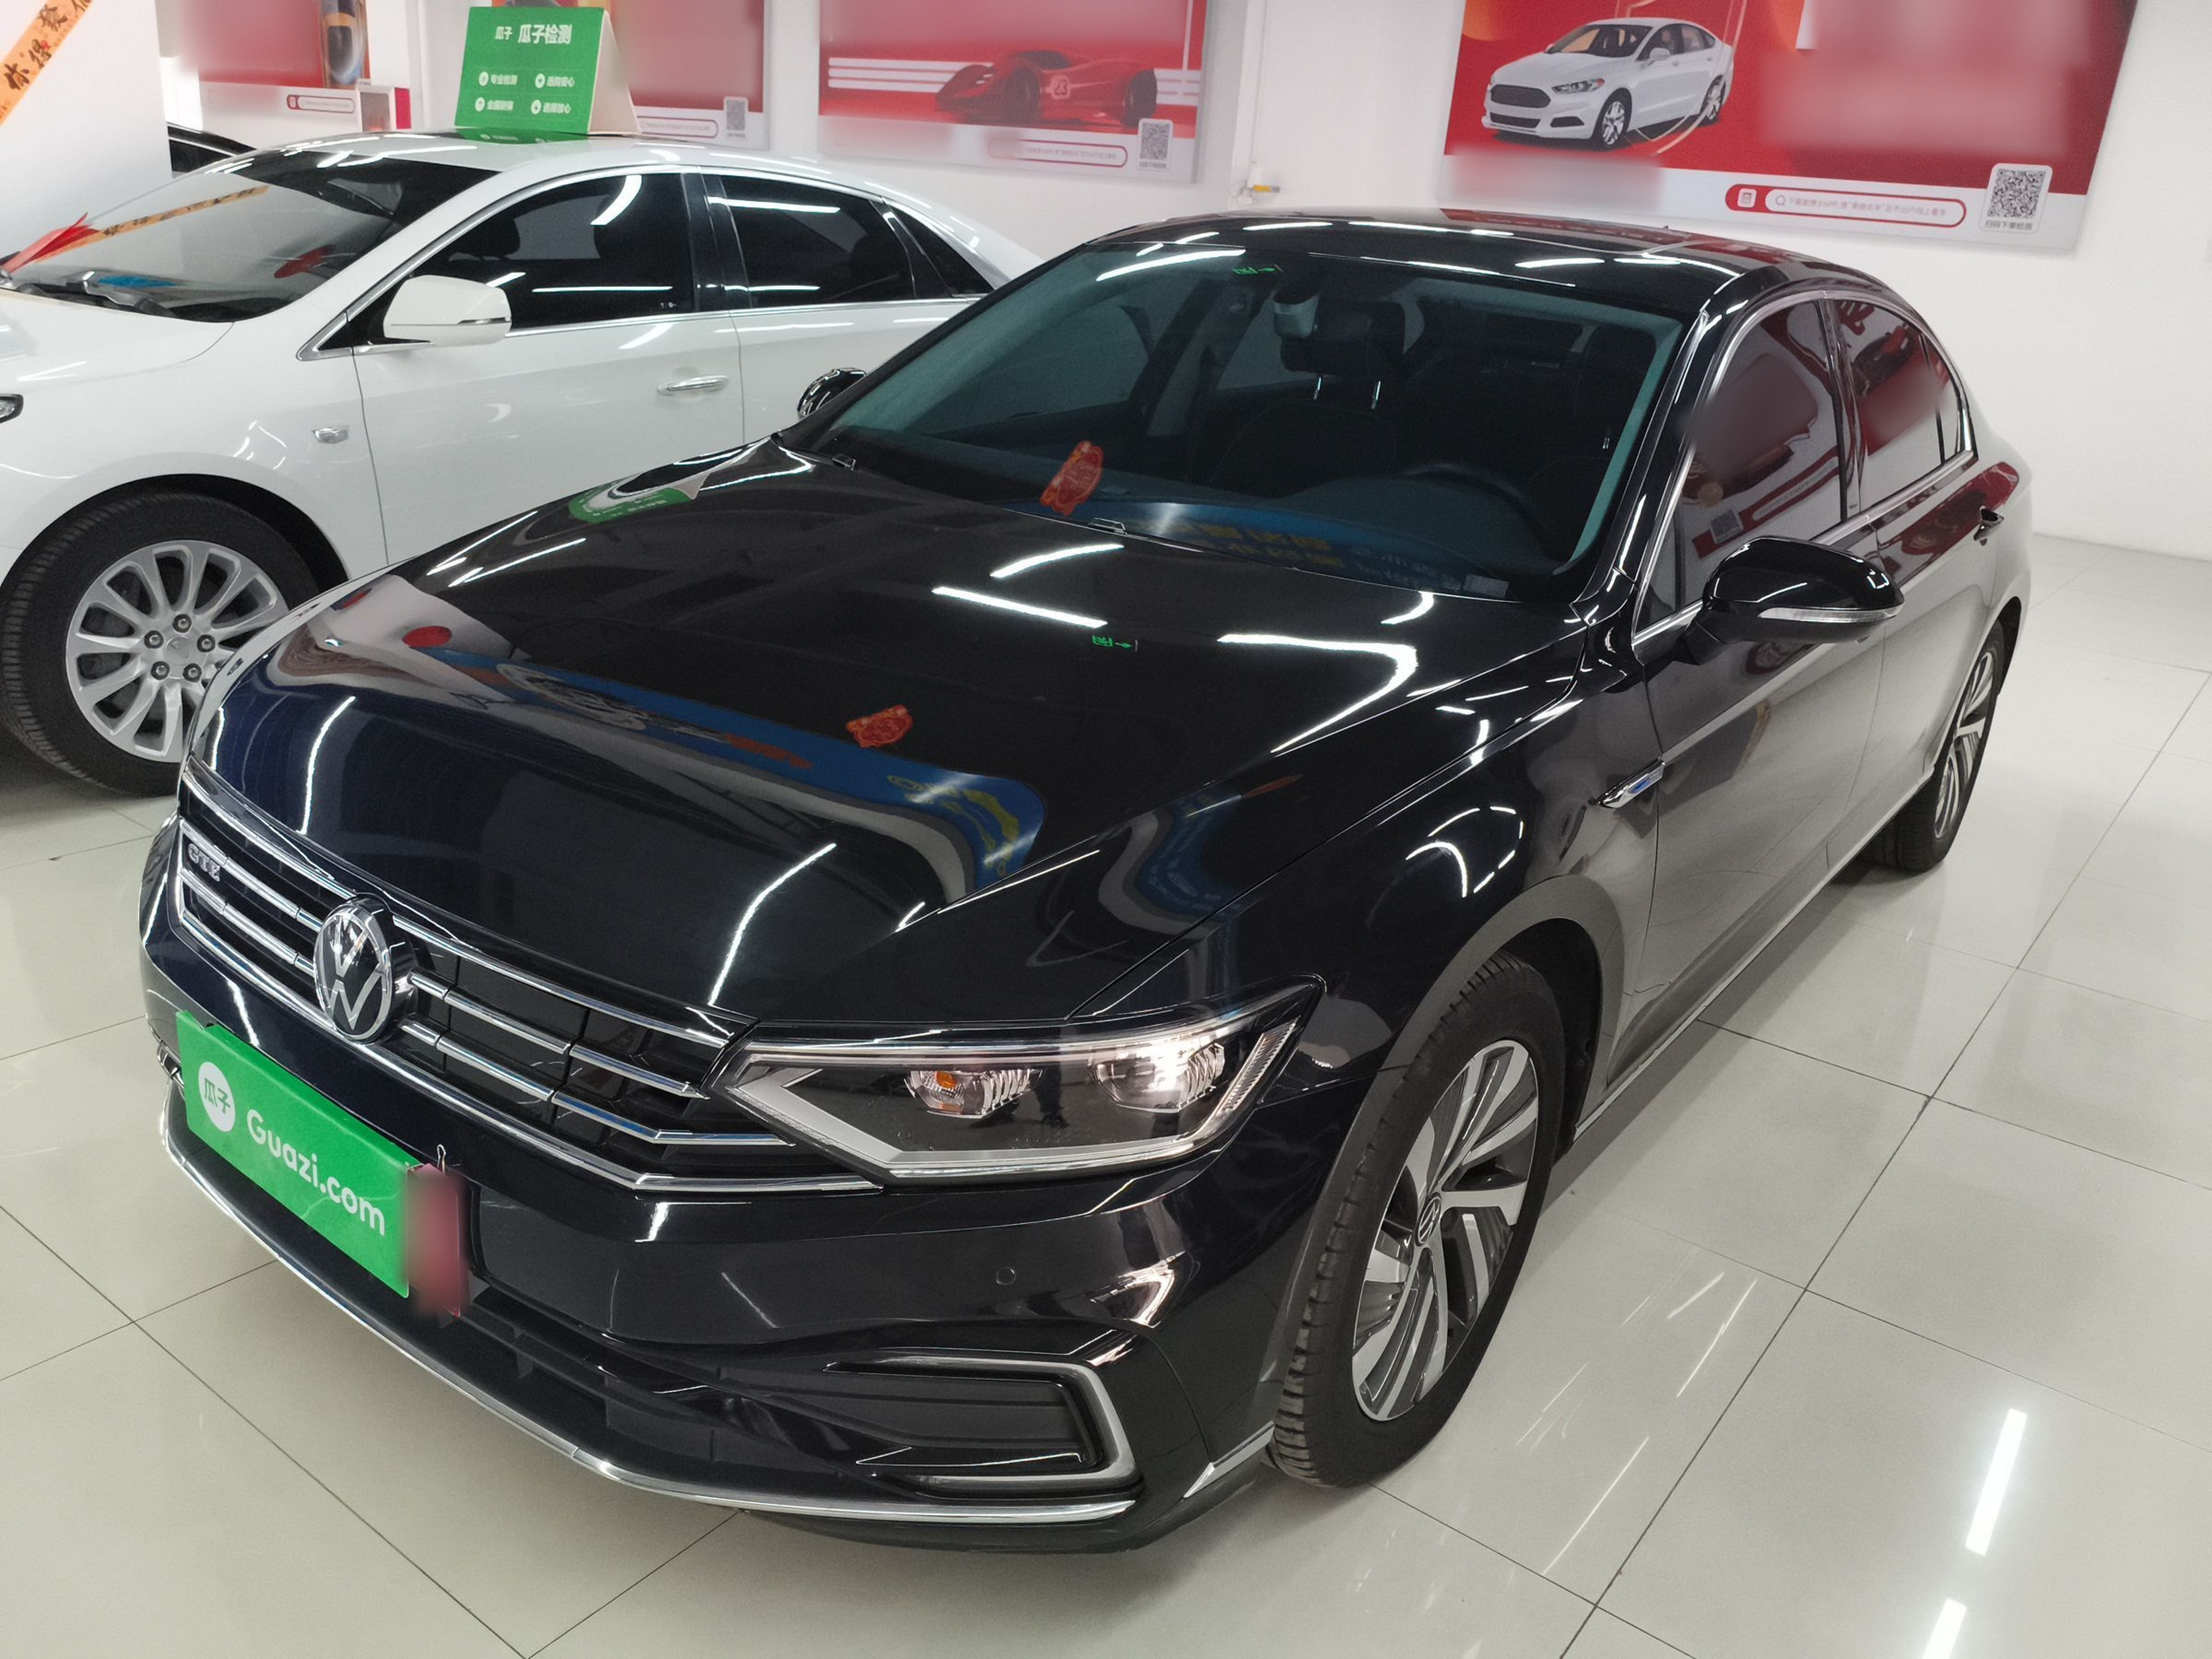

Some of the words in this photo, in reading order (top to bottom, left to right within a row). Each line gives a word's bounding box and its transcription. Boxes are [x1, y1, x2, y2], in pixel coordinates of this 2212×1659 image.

[518, 24, 573, 44] 瓜子检测
[1054, 78, 1068, 96] 23
[187, 843, 221, 882] GTE
[204, 1078, 231, 1114] 瓜子
[247, 1109, 385, 1237] Guazi.com
